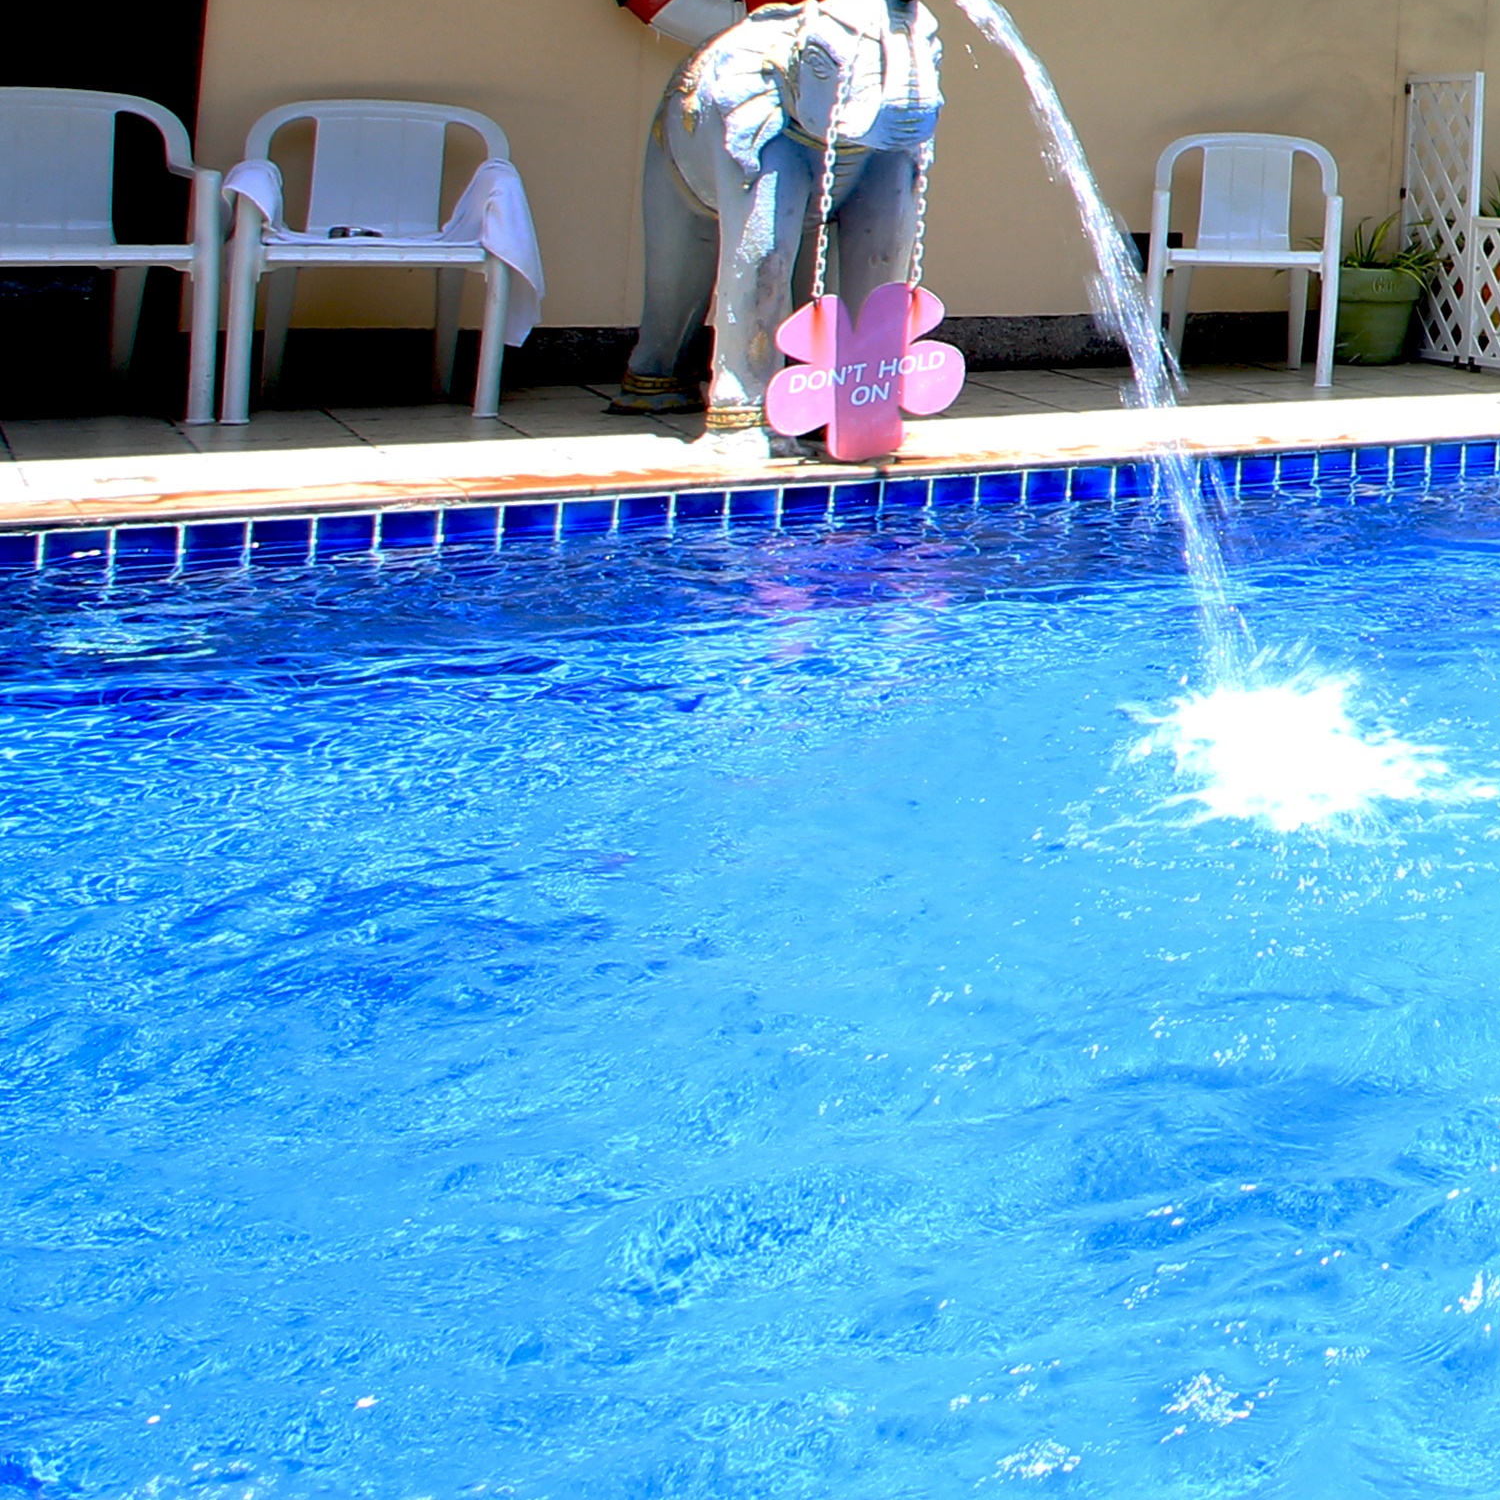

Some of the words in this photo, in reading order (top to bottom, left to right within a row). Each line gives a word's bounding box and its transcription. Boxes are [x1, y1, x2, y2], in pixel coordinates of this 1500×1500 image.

[789, 363, 867, 394] DON'T
[879, 351, 945, 378] HOLD
[851, 382, 890, 406] ON
